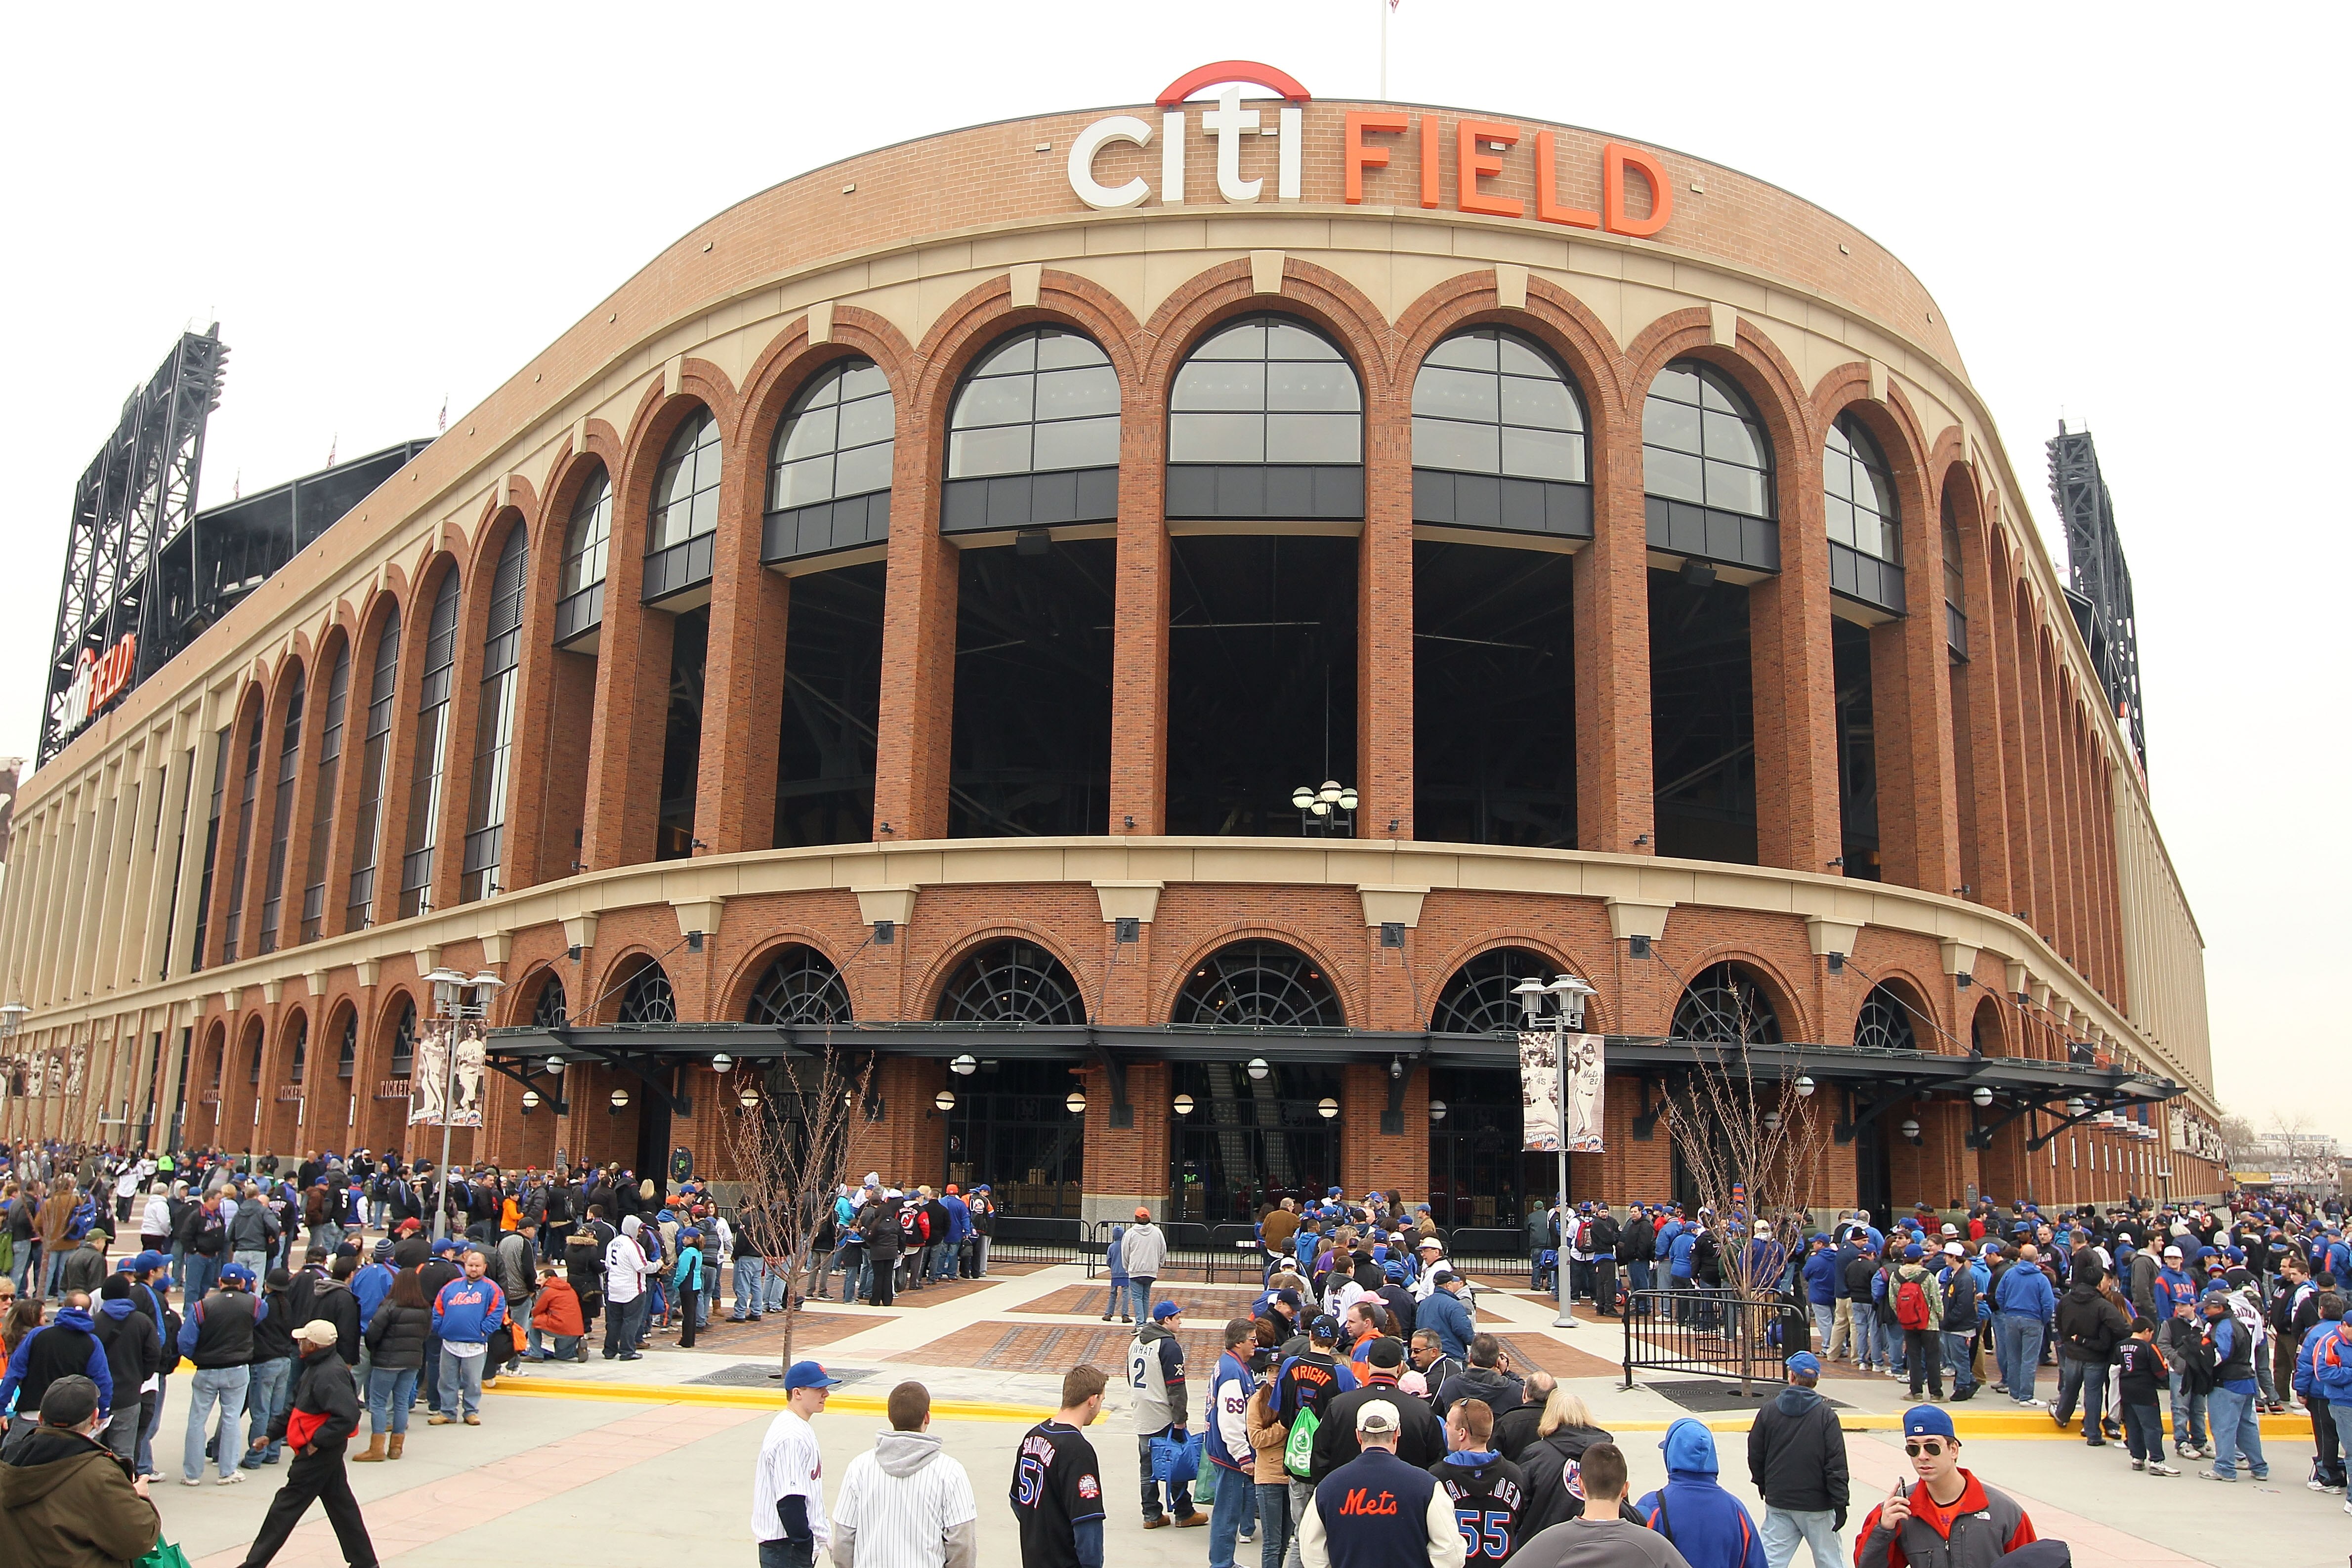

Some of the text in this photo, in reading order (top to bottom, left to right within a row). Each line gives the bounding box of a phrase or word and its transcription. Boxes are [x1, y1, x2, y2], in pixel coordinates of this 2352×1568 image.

[1068, 85, 1674, 239] citi FIELD
[1570, 1135, 1588, 1145] KNIGHT
[611, 1249, 618, 1265] 5
[448, 1291, 482, 1306] Mets
[1332, 1299, 1341, 1319] 5
[1133, 1344, 1154, 1356] WHAT
[2123, 1353, 2133, 1372] 5
[1133, 1356, 1147, 1390] 2
[1291, 1364, 1333, 1387] WRIGHT
[1340, 1487, 1397, 1516] Mets
[1455, 1509, 1511, 1560] 55
